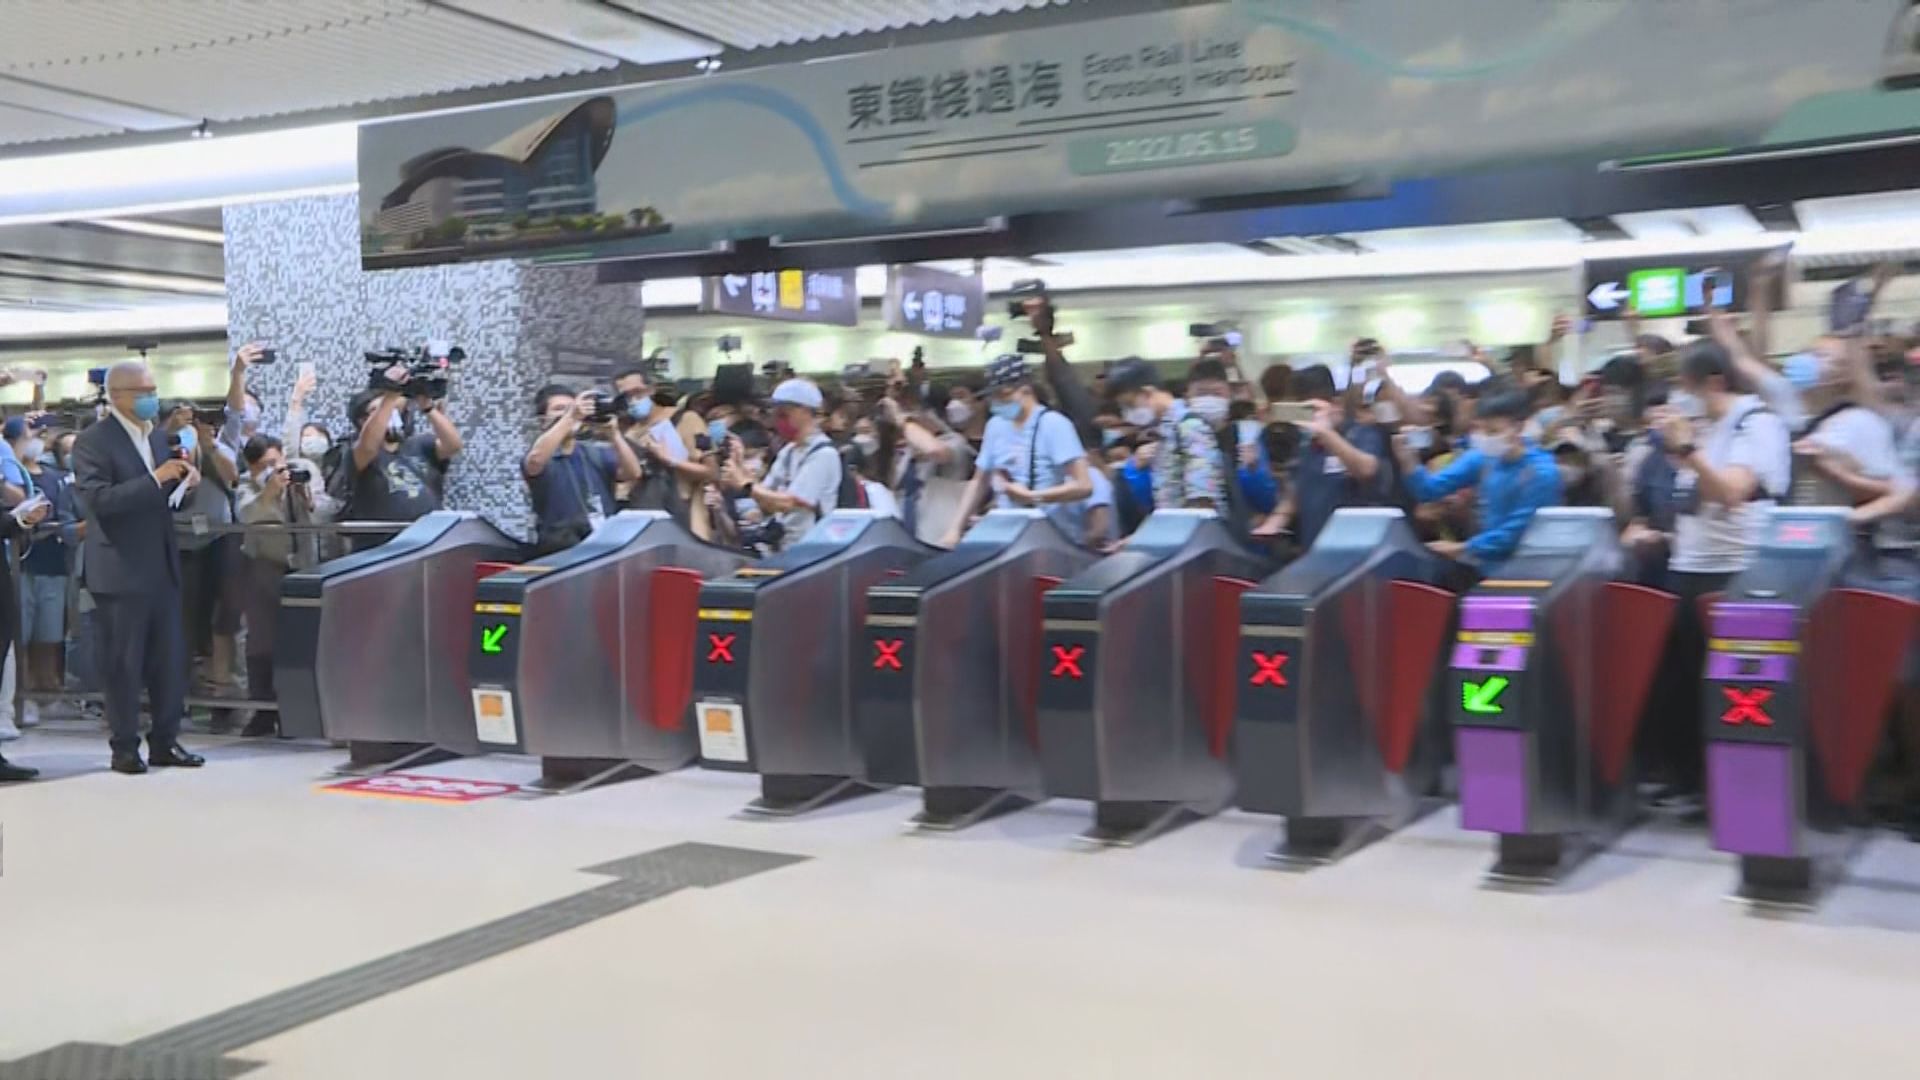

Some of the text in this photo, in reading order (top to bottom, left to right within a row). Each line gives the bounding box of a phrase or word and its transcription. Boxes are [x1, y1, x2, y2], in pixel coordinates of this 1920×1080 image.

[1084, 39, 1242, 77] East Rail Line
[1084, 61, 1295, 101] Crossing Harbour
[1105, 127, 1257, 165] 2022.05.15
